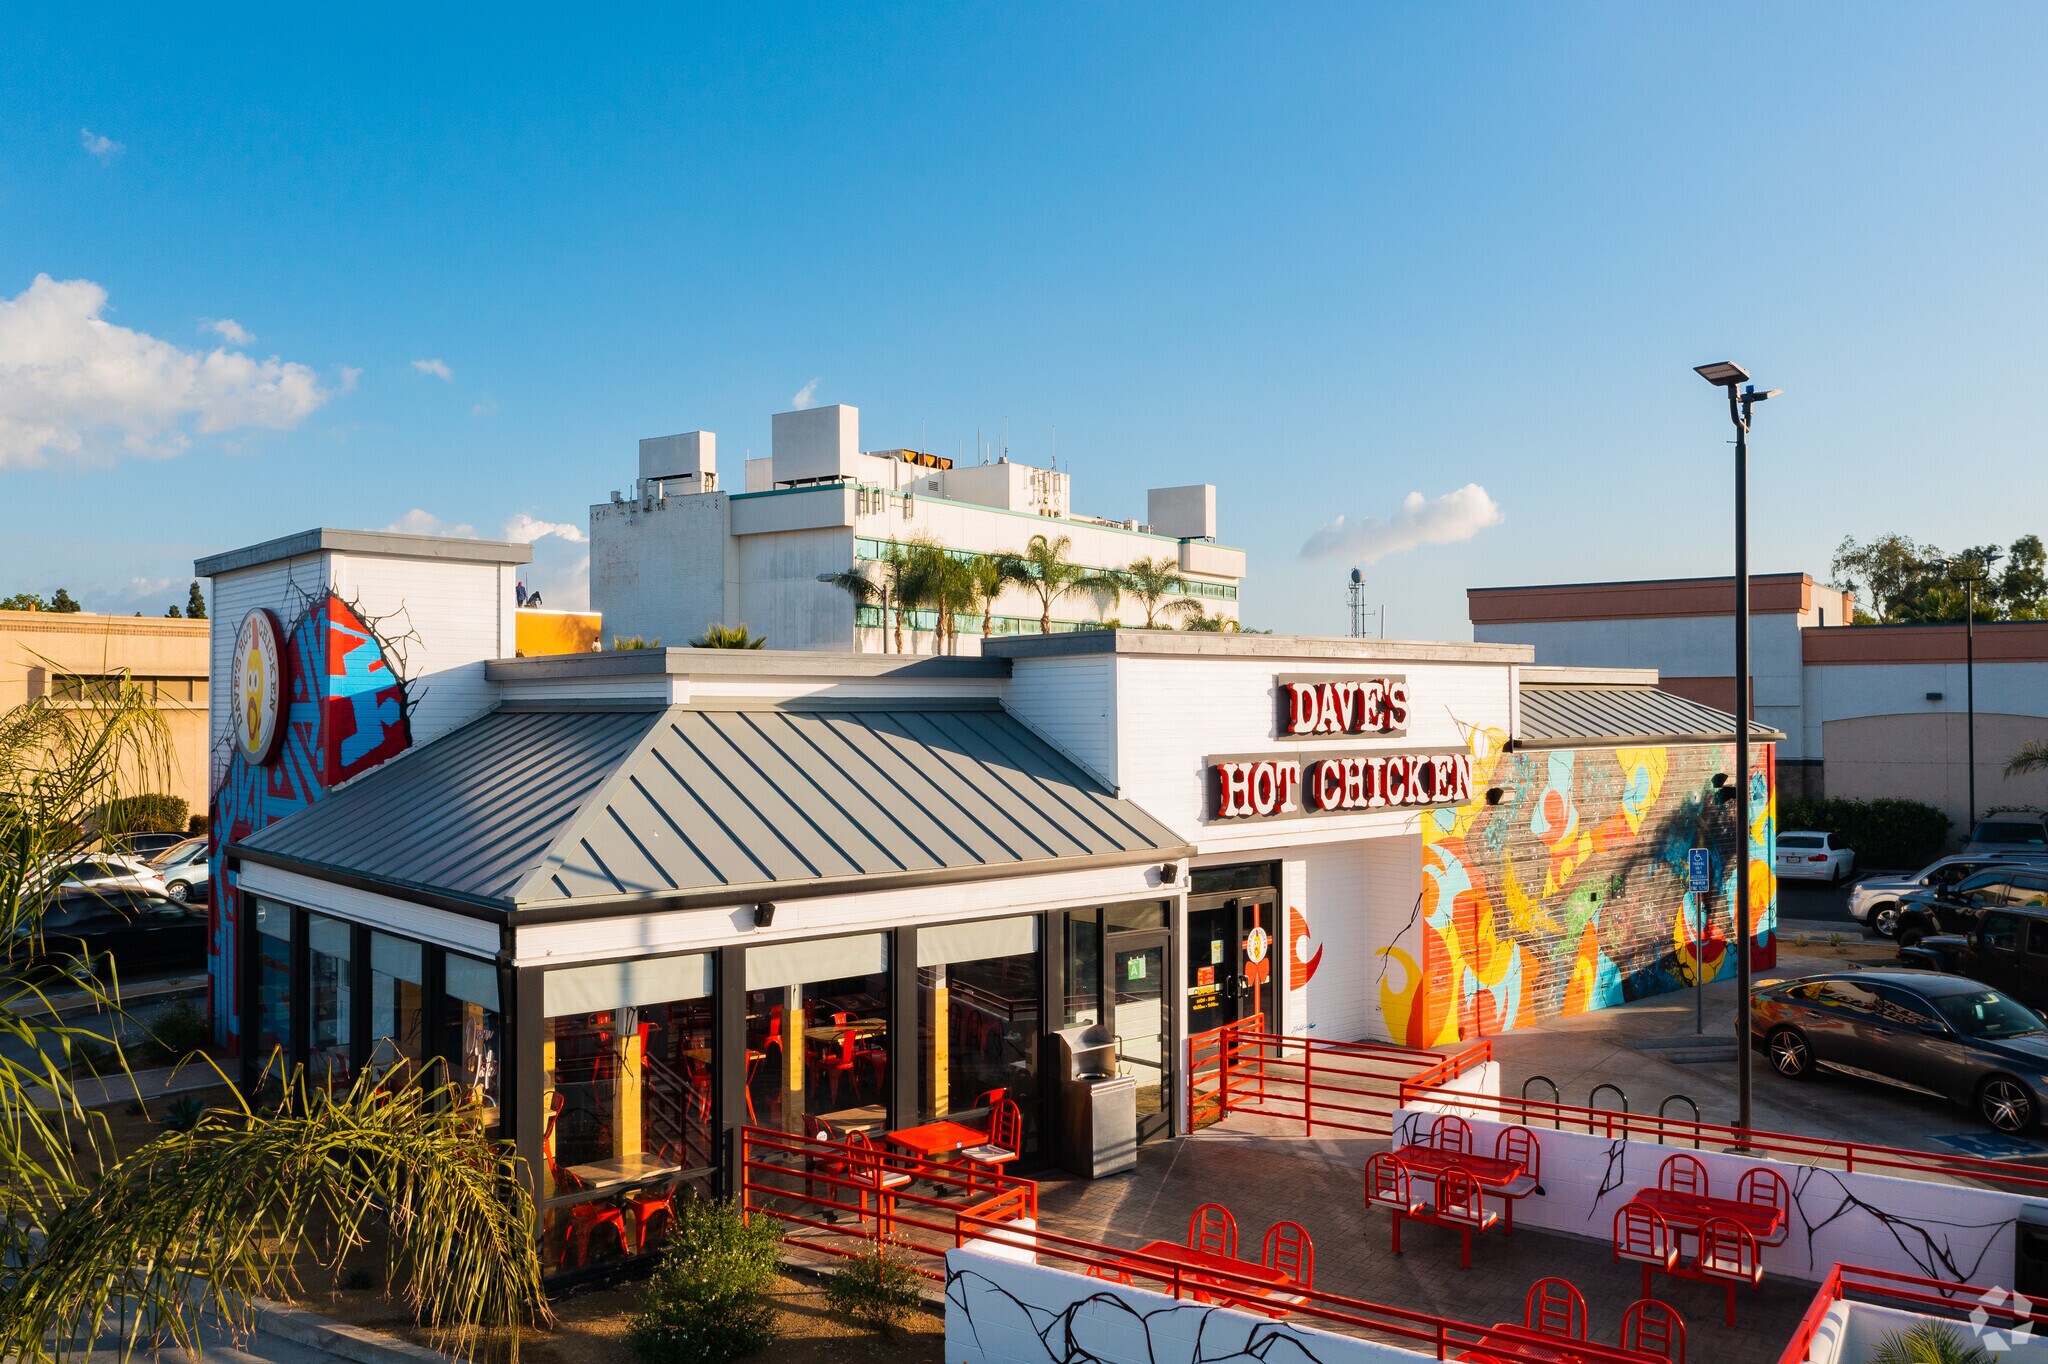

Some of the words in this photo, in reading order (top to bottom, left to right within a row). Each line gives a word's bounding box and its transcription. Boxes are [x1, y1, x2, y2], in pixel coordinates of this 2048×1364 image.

[233, 656, 243, 728] DAVE'S
[239, 621, 252, 656] HOT
[258, 619, 277, 712] CHICKEN
[1287, 678, 1411, 733] DAVE'S
[1217, 760, 1300, 817] HOT
[1314, 753, 1475, 810] CHICKEN
[1131, 964, 1138, 976] A
